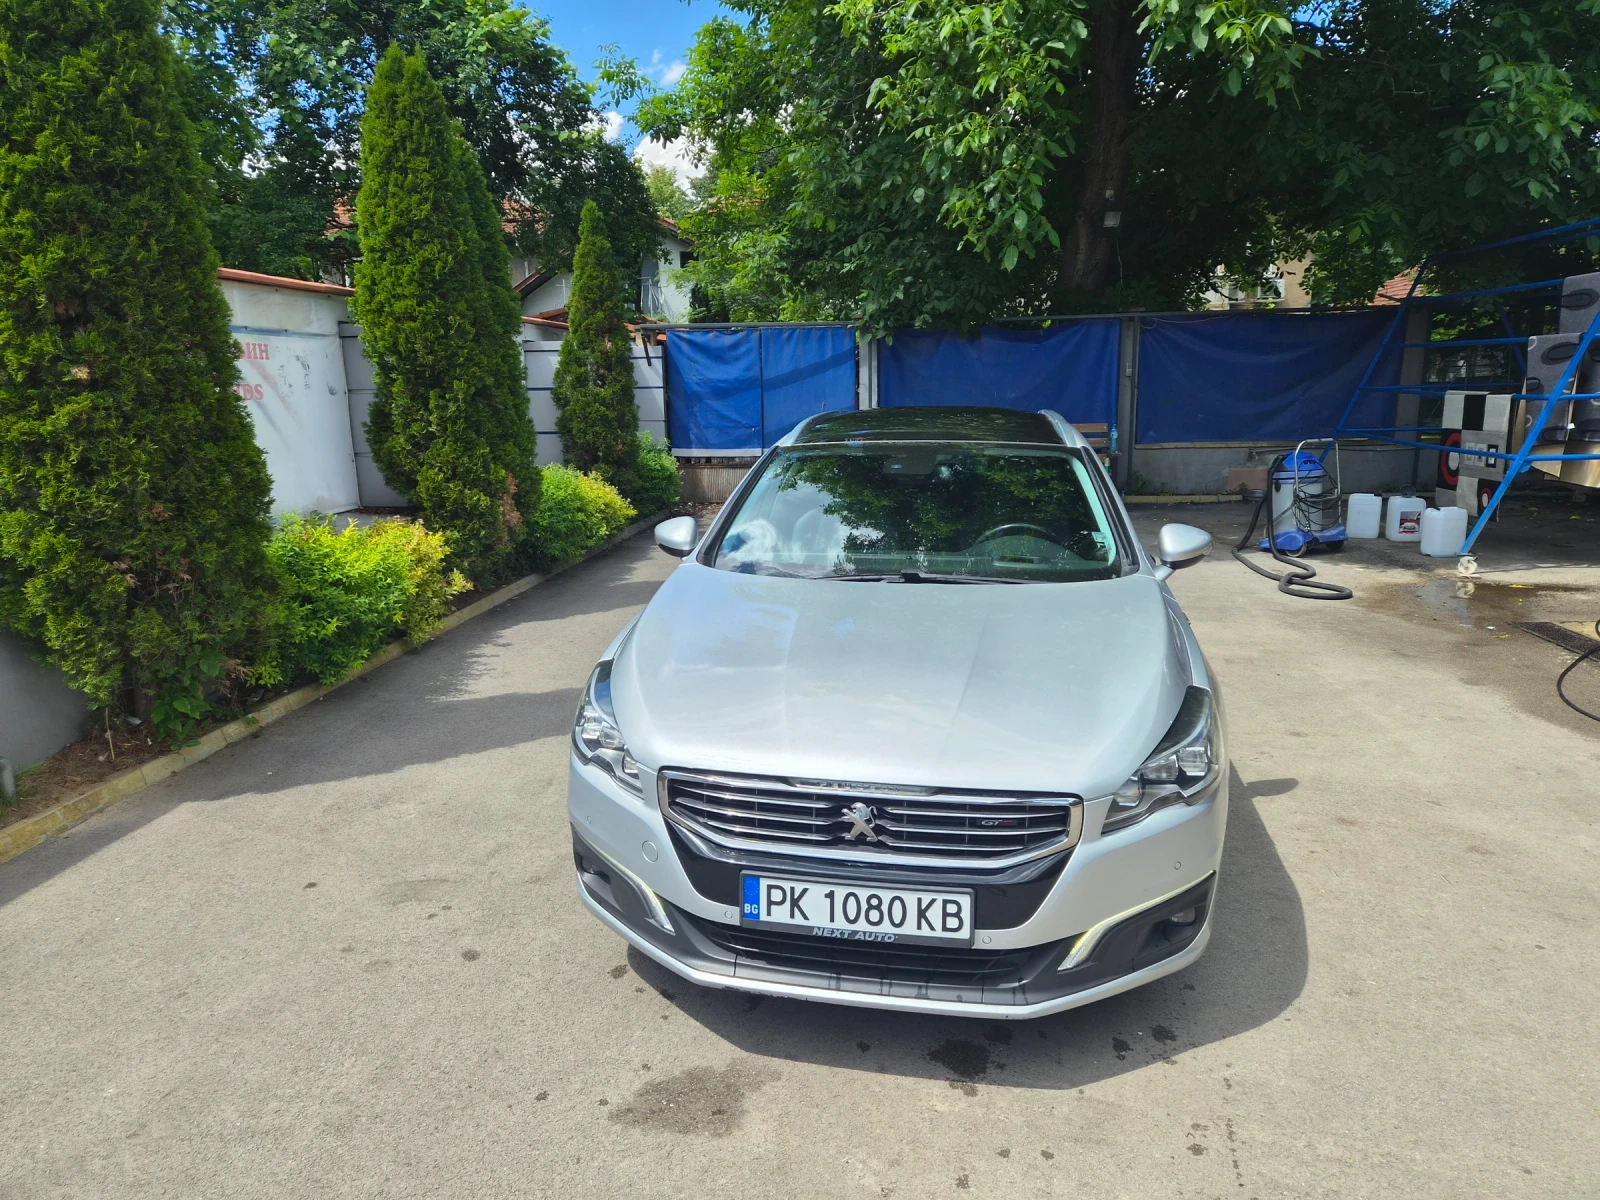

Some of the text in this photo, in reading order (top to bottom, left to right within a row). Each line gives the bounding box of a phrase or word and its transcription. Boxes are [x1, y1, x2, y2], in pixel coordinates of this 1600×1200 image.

[744, 903, 759, 915] BG
[766, 883, 964, 933] PK 1080 KB
[812, 927, 895, 943] NEXT AUTO
